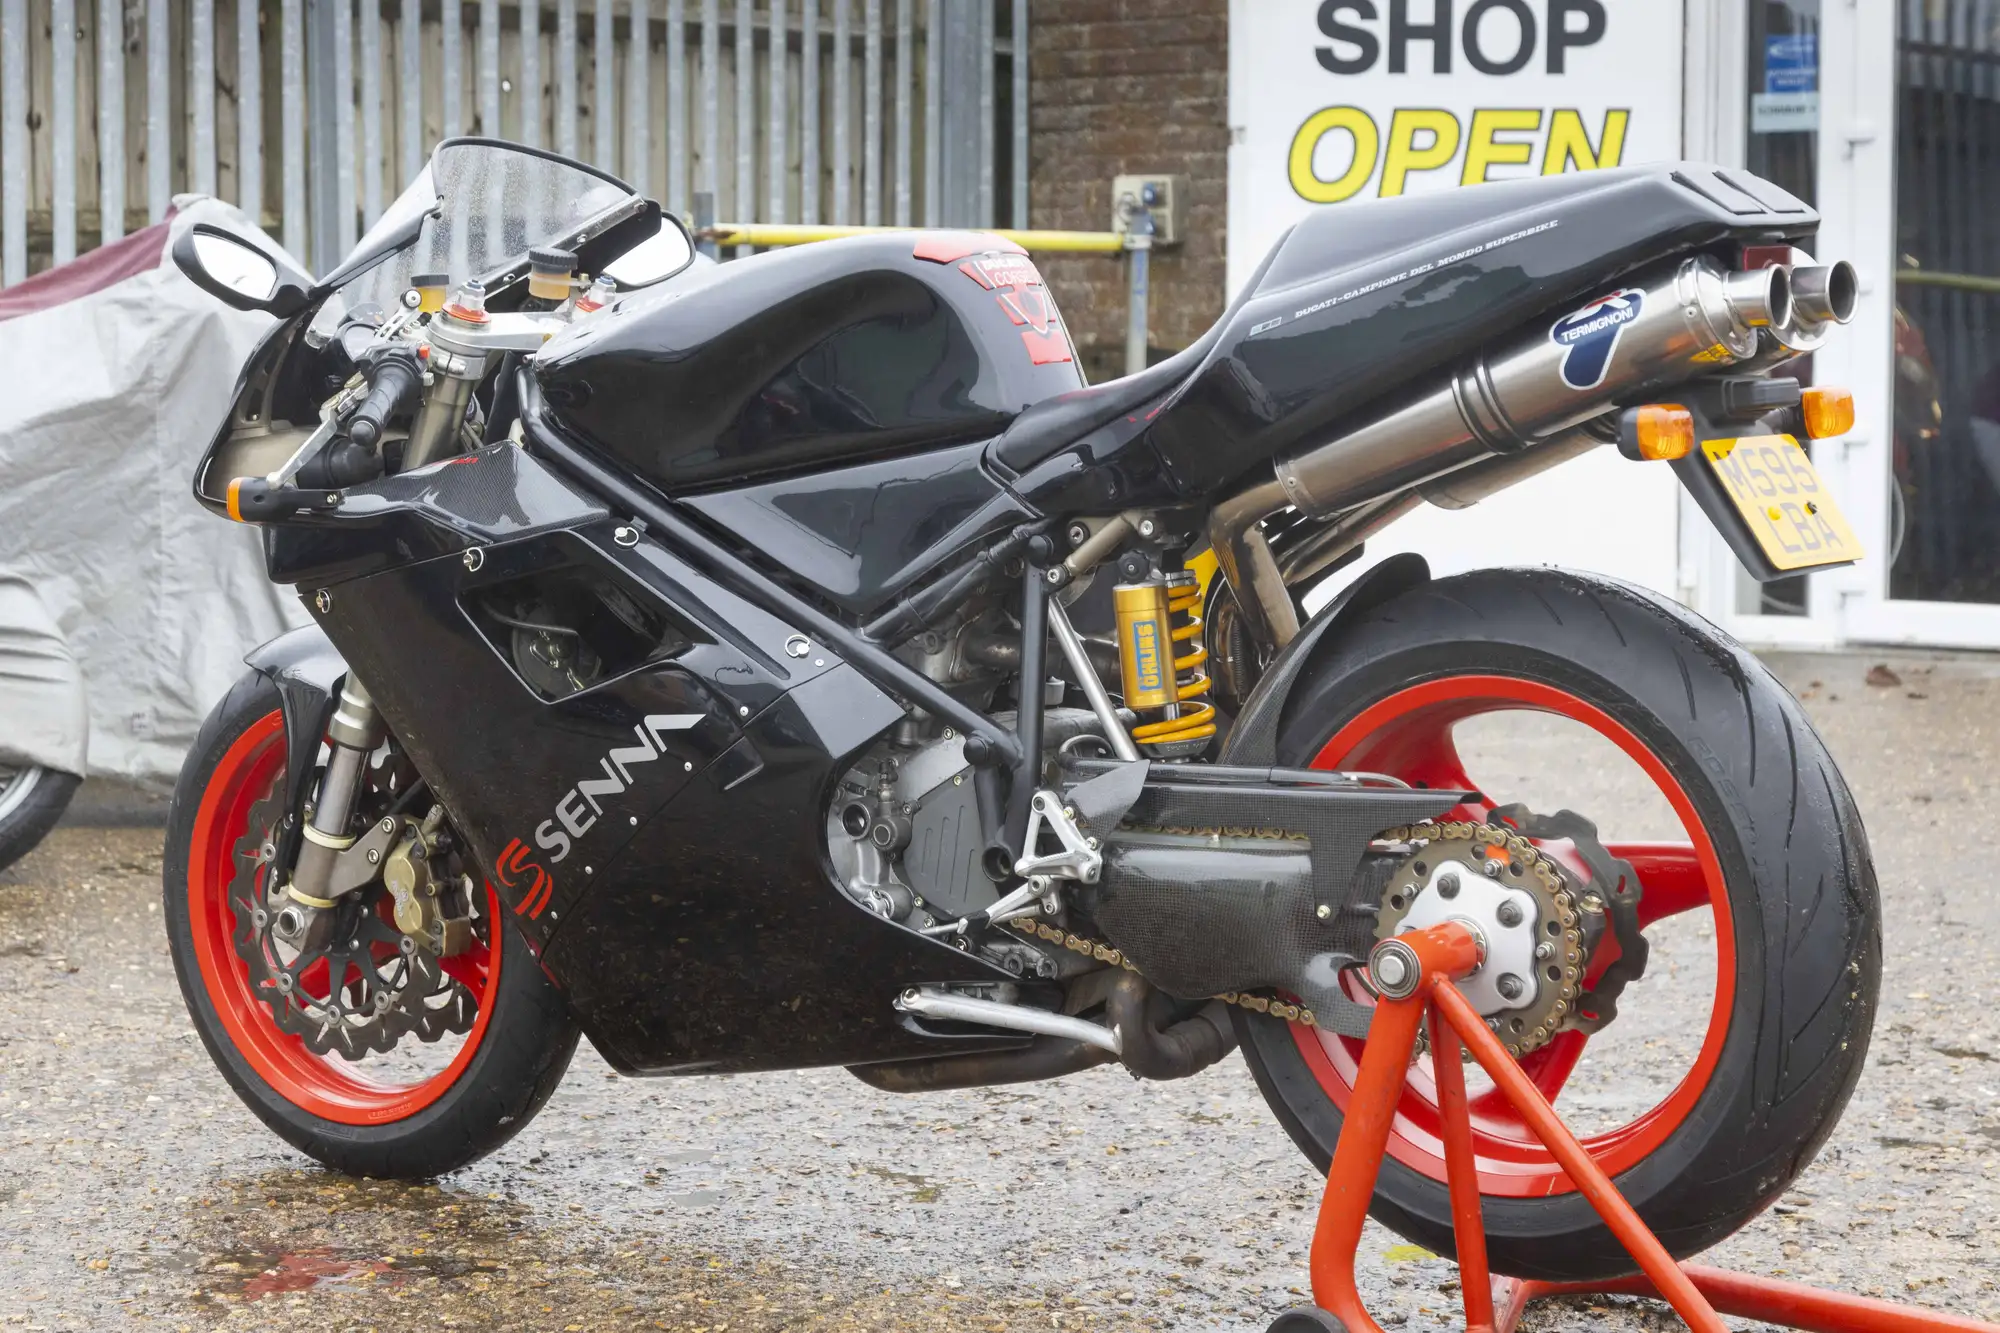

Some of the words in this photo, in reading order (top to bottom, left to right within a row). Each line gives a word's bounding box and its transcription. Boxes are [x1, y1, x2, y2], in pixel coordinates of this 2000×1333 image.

[1315, 0, 1607, 75] SHOP
[1287, 105, 1631, 204] OPEN
[1295, 272, 1407, 318] DUCATI-CAMPIONE
[1410, 262, 1434, 278] DEL
[1438, 245, 1484, 268] MONDO
[1485, 219, 1559, 250] SUPERBIKE
[1561, 307, 1634, 342] TERMIGNONI
[1713, 445, 1819, 500] M595
[1758, 503, 1844, 553] LBA
[534, 714, 707, 864] SENNA
